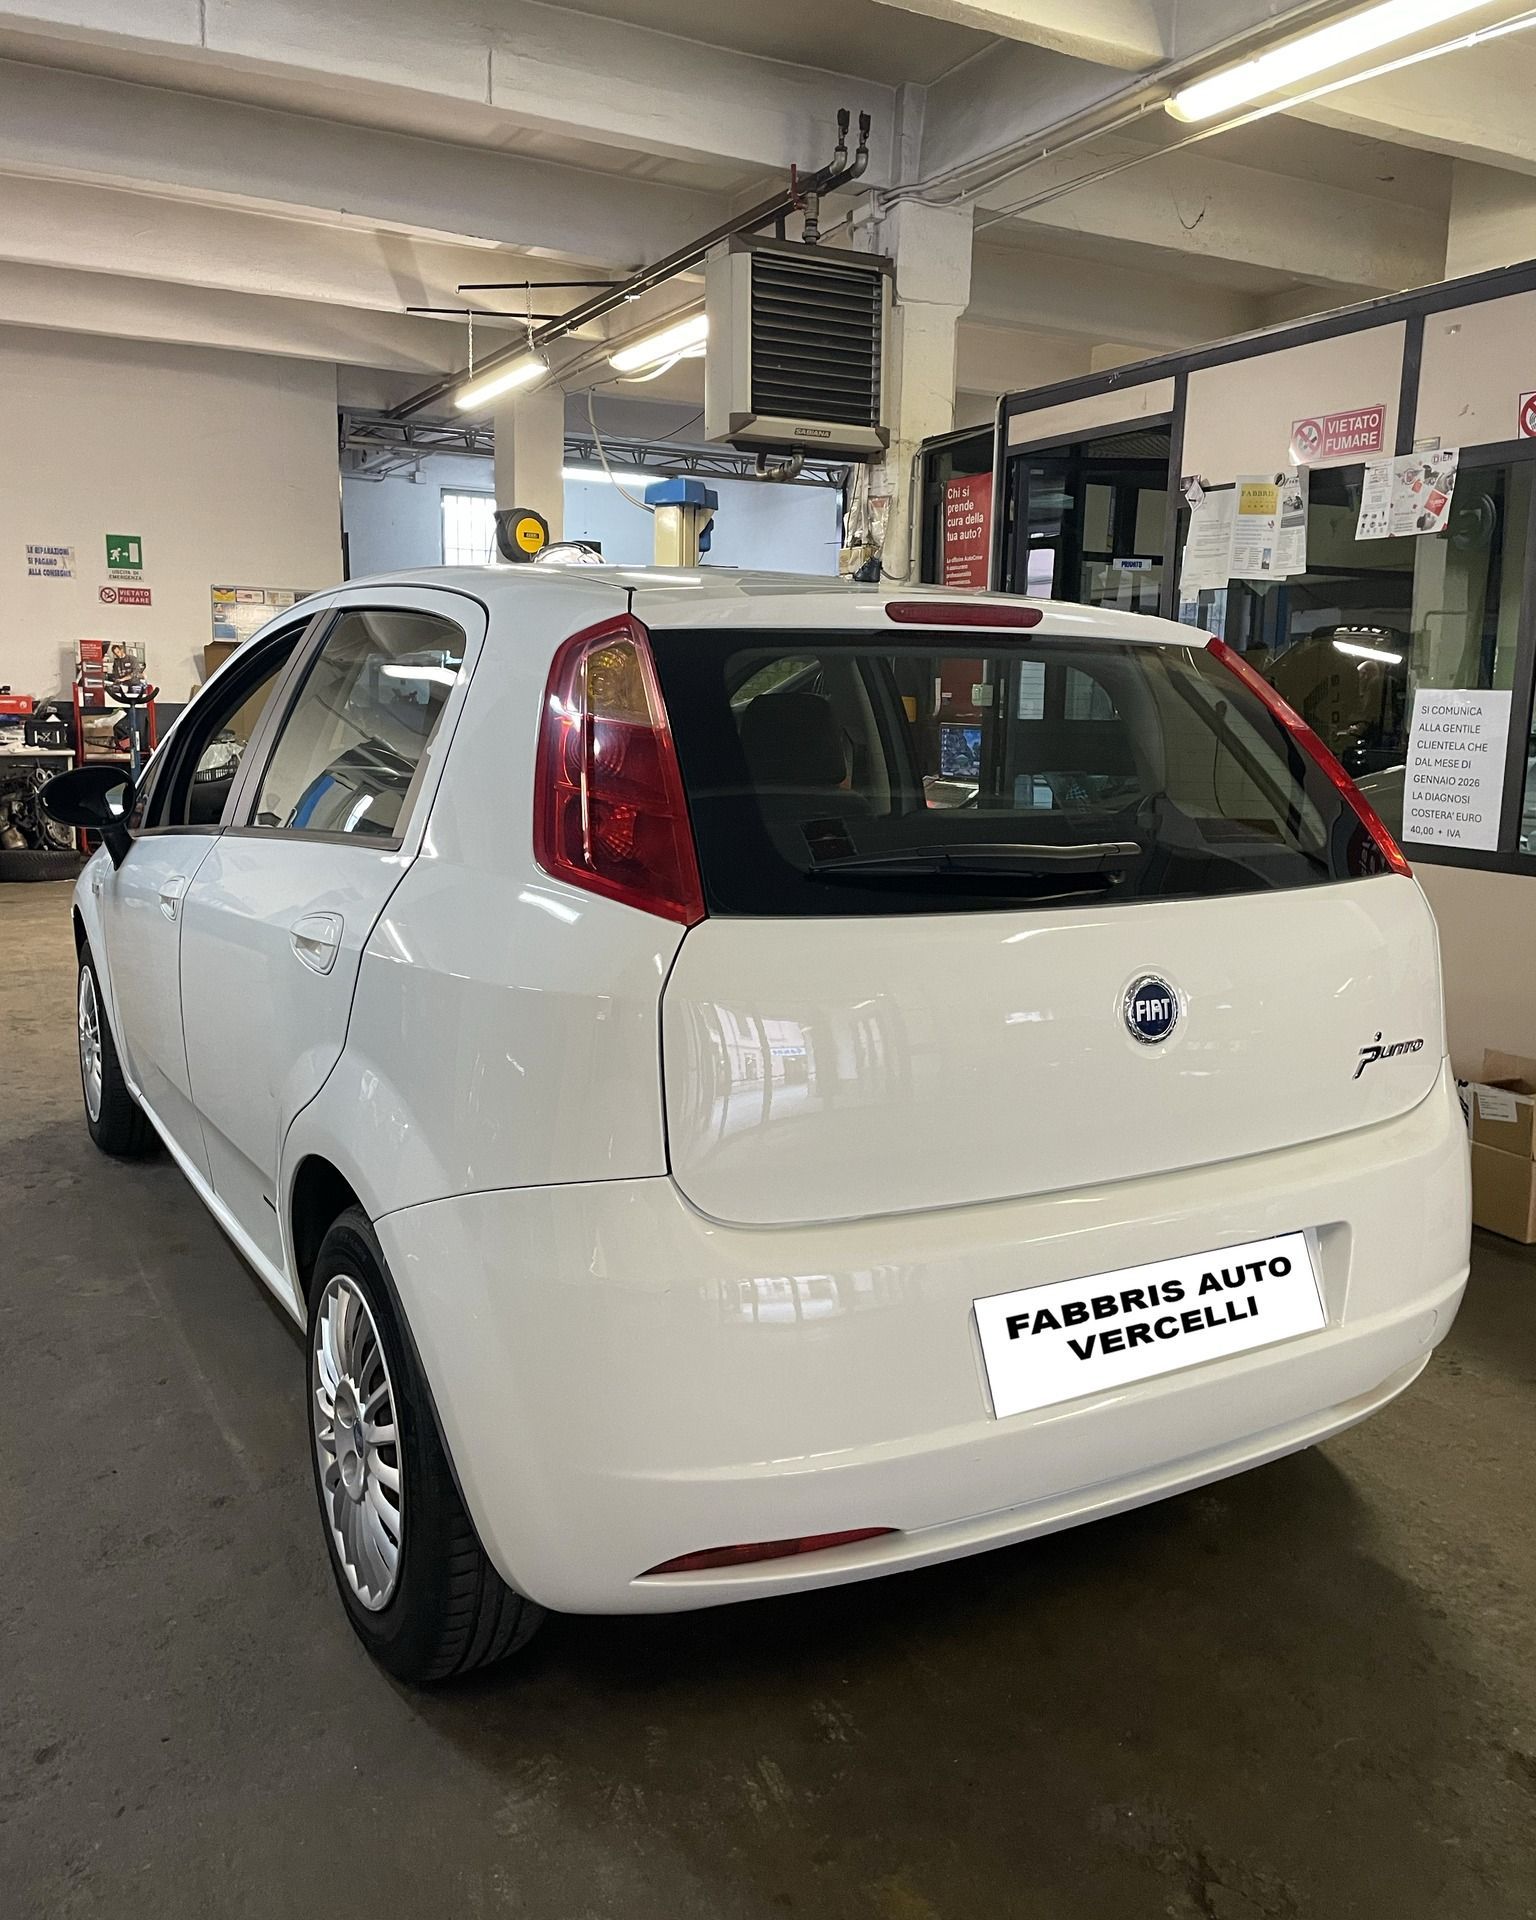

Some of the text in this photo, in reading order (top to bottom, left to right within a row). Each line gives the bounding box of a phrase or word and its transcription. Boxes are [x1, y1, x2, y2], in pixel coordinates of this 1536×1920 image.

[1327, 413, 1379, 434] VIETATO
[795, 429, 830, 437] SABIANA
[1325, 431, 1378, 451] FUMARE
[947, 486, 970, 499] Chi si
[947, 500, 974, 516] prende
[947, 512, 984, 527] cura della
[947, 527, 982, 542] tua auto?
[28, 568, 72, 577] ALLA CONSEGNA
[119, 596, 150, 604] FUMARE
[1421, 706, 1483, 716] SI COMUNICA
[1419, 723, 1481, 734] ALLA GENTILE
[1417, 740, 1489, 752] CLIENTELA CHE
[1415, 757, 1472, 769] DAL MESE DI
[1413, 774, 1480, 787] GENNAIO 2026
[1412, 791, 1470, 804] LA DIAGNOSI
[1411, 808, 1482, 823] COSTERA' EURO
[1410, 825, 1434, 836] 40,00
[1447, 829, 1461, 838] IVA
[1136, 998, 1171, 1022] FIAT
